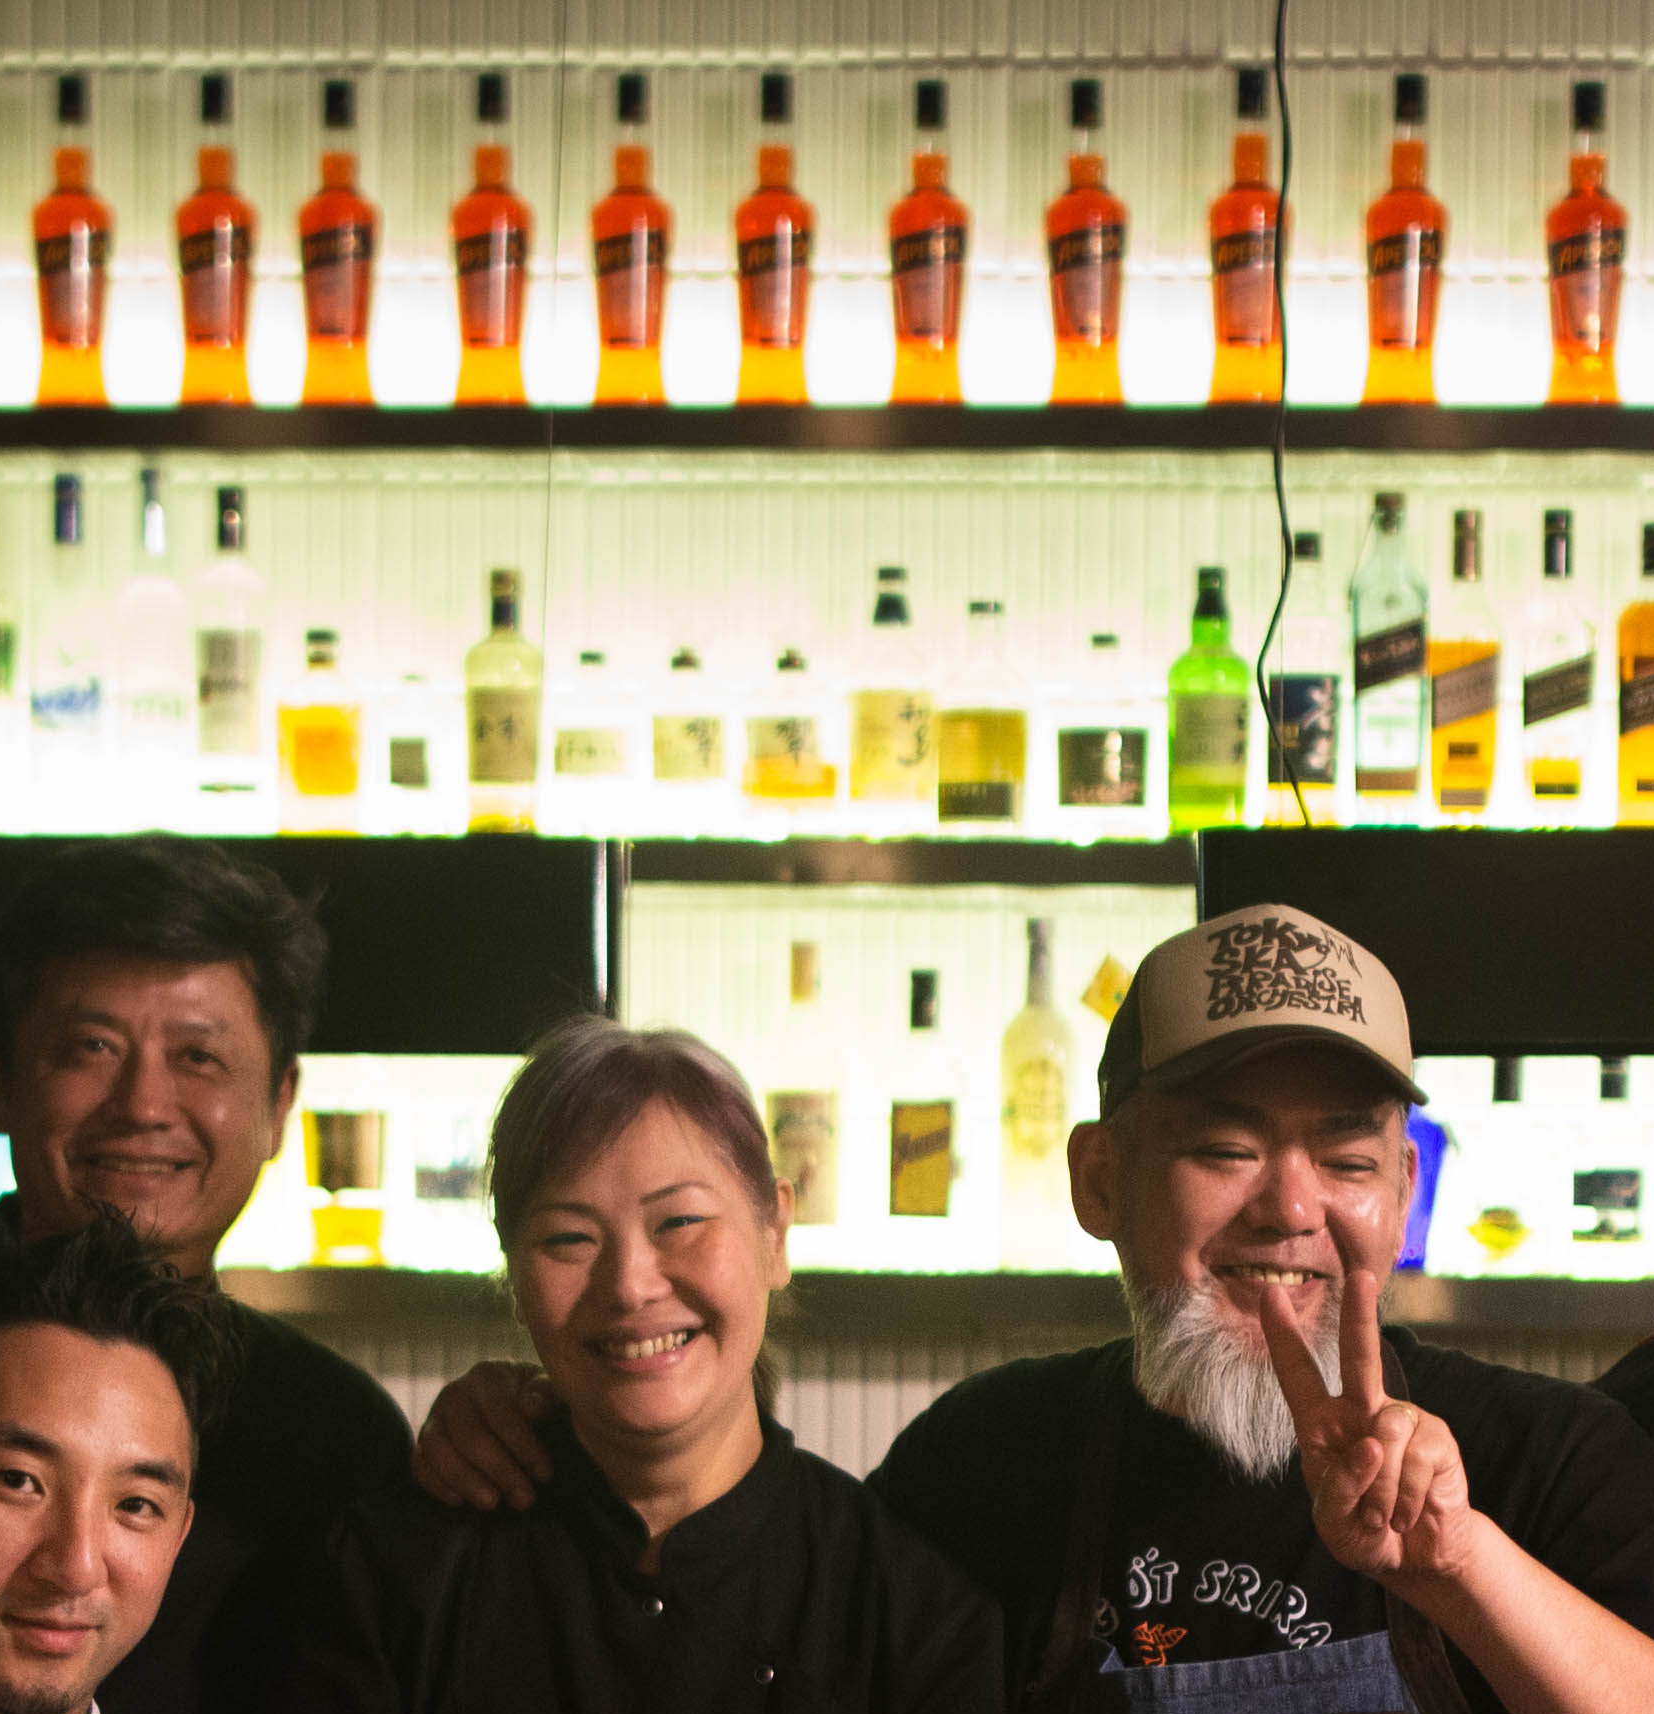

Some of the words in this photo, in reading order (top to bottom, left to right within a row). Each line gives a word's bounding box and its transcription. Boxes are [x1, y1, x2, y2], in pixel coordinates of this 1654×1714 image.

[1206, 917, 1330, 954] TOKYO
[1210, 944, 1308, 975] SKA
[1205, 967, 1352, 1003] PARADISE
[1206, 988, 1368, 1025] ORCHESTRA
